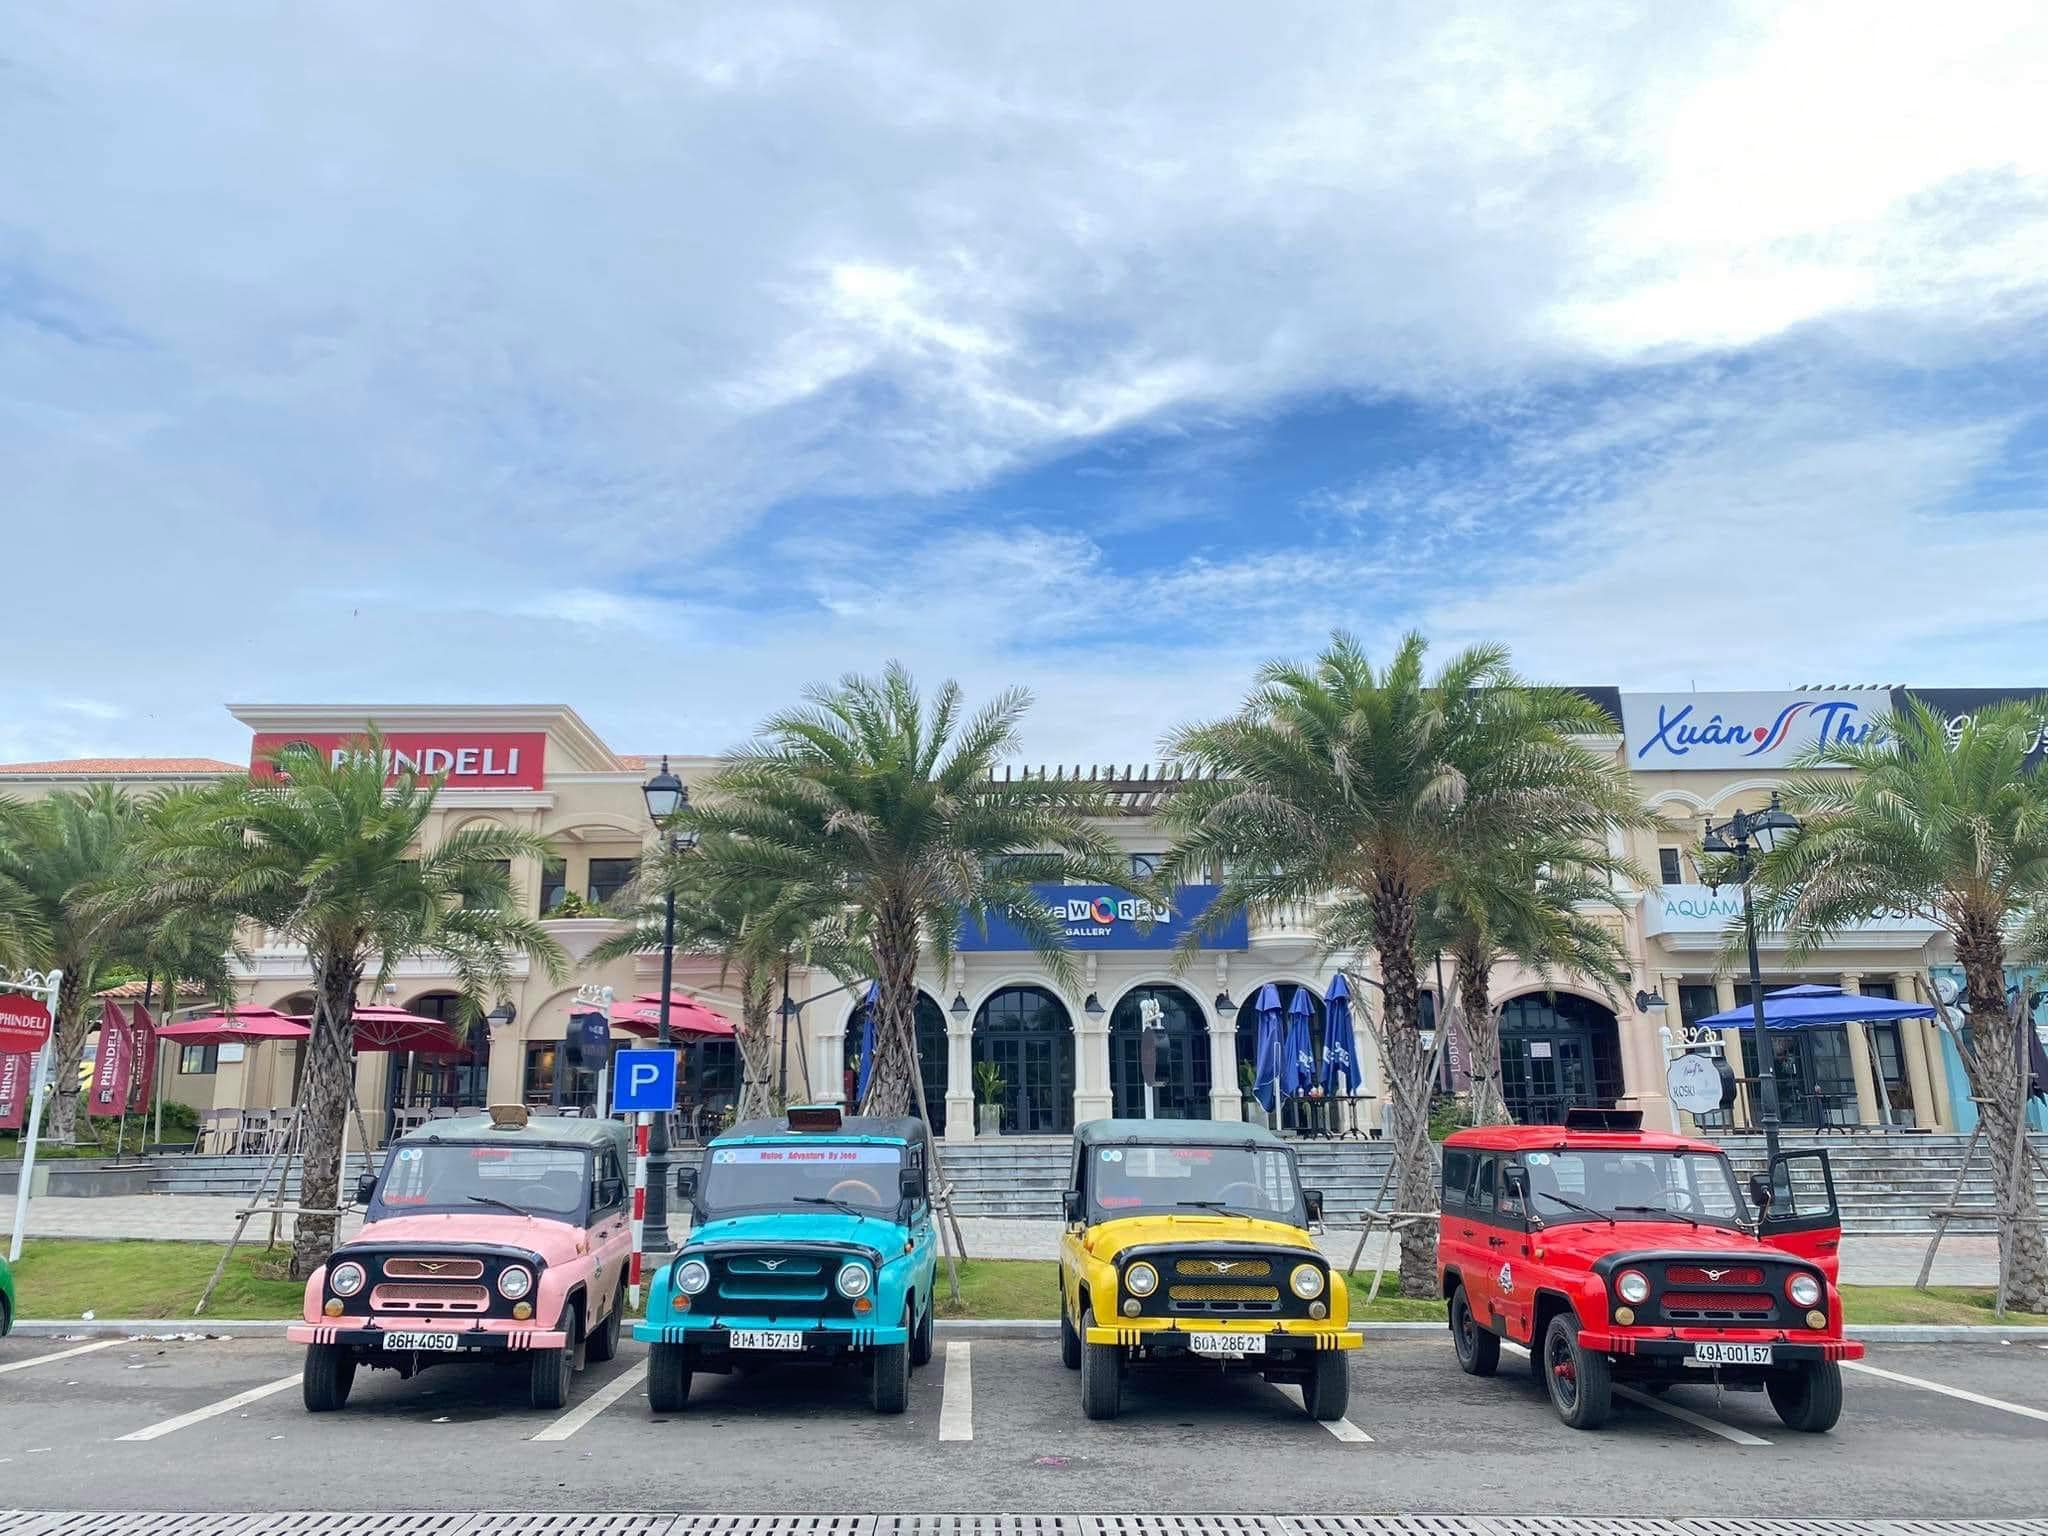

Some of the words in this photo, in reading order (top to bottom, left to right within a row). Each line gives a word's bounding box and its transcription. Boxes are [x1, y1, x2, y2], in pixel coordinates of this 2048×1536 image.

[1638, 704, 1752, 758] Xuân
[331, 748, 519, 775] PHINDELI
[1665, 900, 1744, 919] AQUAM
[1065, 927, 1112, 936] GALLERY
[0, 1012, 47, 1029] PHINDELI
[101, 1028, 118, 1086] PHINDELI
[0, 1055, 15, 1100] PHINDE
[630, 1064, 660, 1097] P
[387, 1334, 454, 1349] 86H-4050
